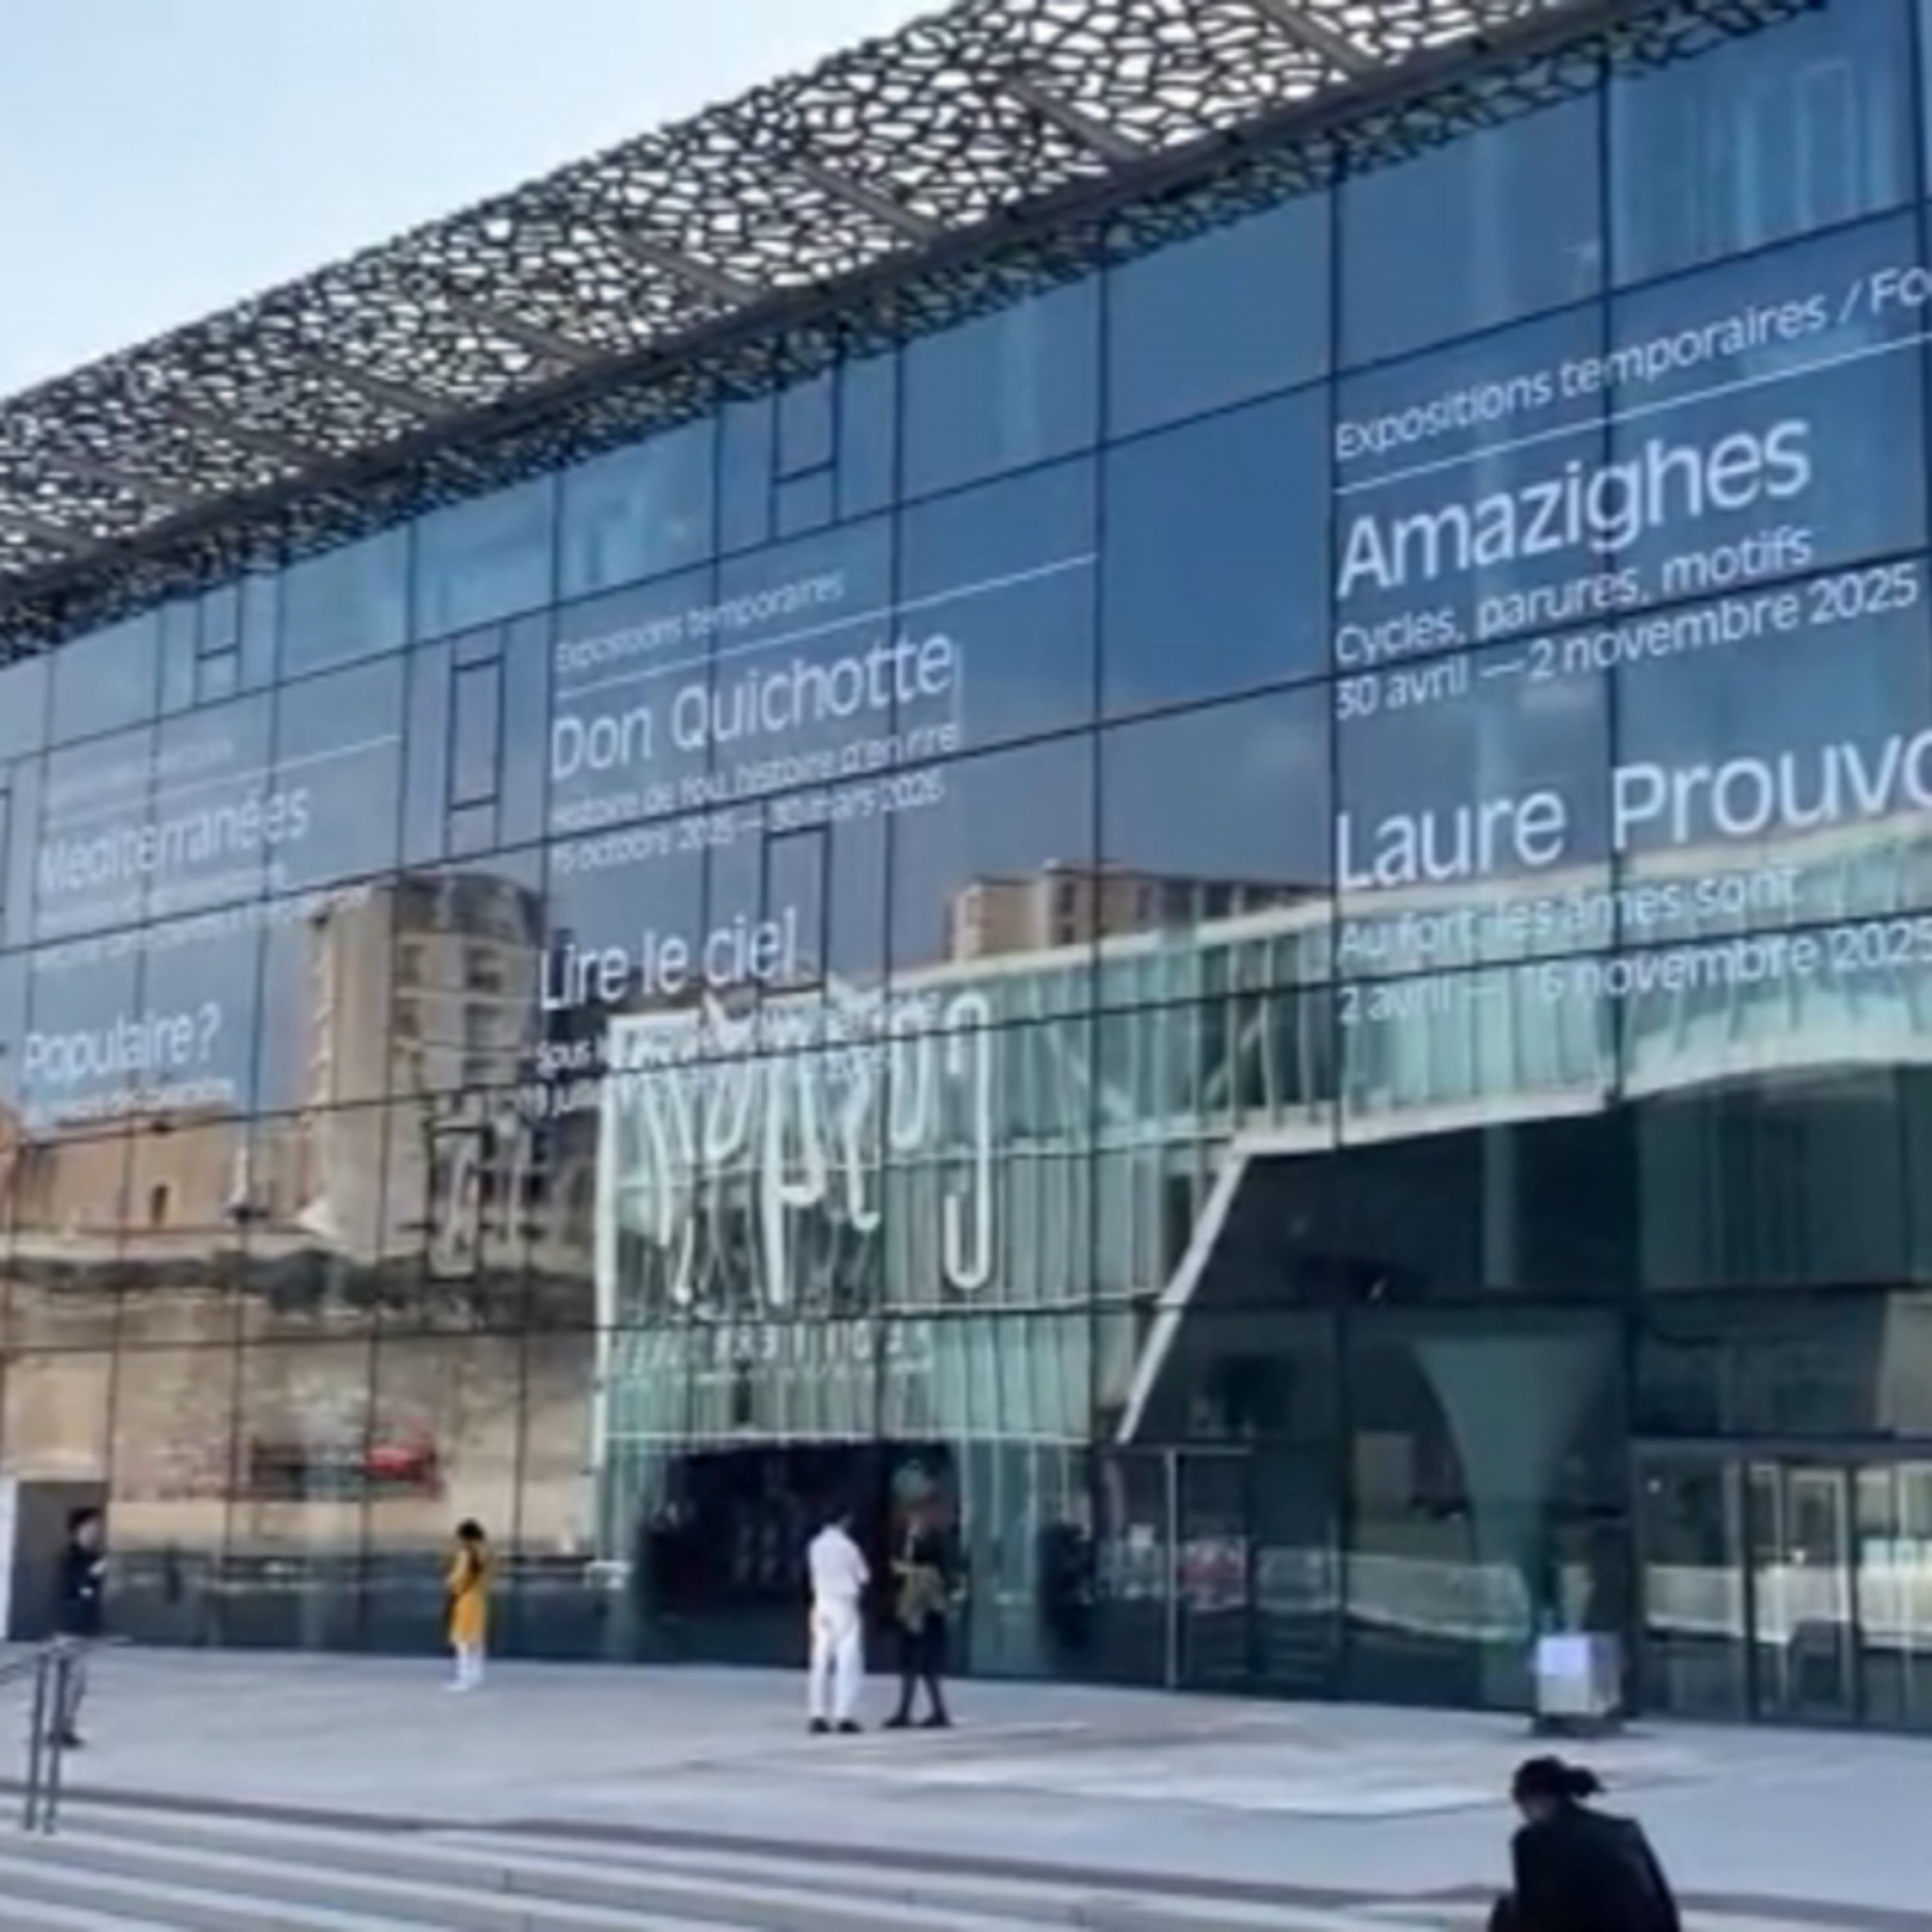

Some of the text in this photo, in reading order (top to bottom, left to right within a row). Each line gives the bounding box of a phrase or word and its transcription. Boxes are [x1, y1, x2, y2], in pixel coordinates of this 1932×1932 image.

[1336, 371, 1553, 462] Expositions
[1558, 292, 1828, 399] temporaires
[1336, 419, 1812, 600] Amazighes
[1386, 654, 1468, 710] avril
[1564, 592, 1799, 672] novembre
[1808, 562, 1919, 625] 2025
[1478, 567, 1650, 639] parures,
[1663, 524, 1812, 595] motifs
[551, 632, 954, 781] Don Quichotte
[1336, 789, 1566, 891] Laure
[540, 905, 798, 1012] Lire le ciel
[1569, 932, 1820, 1005] novembre
